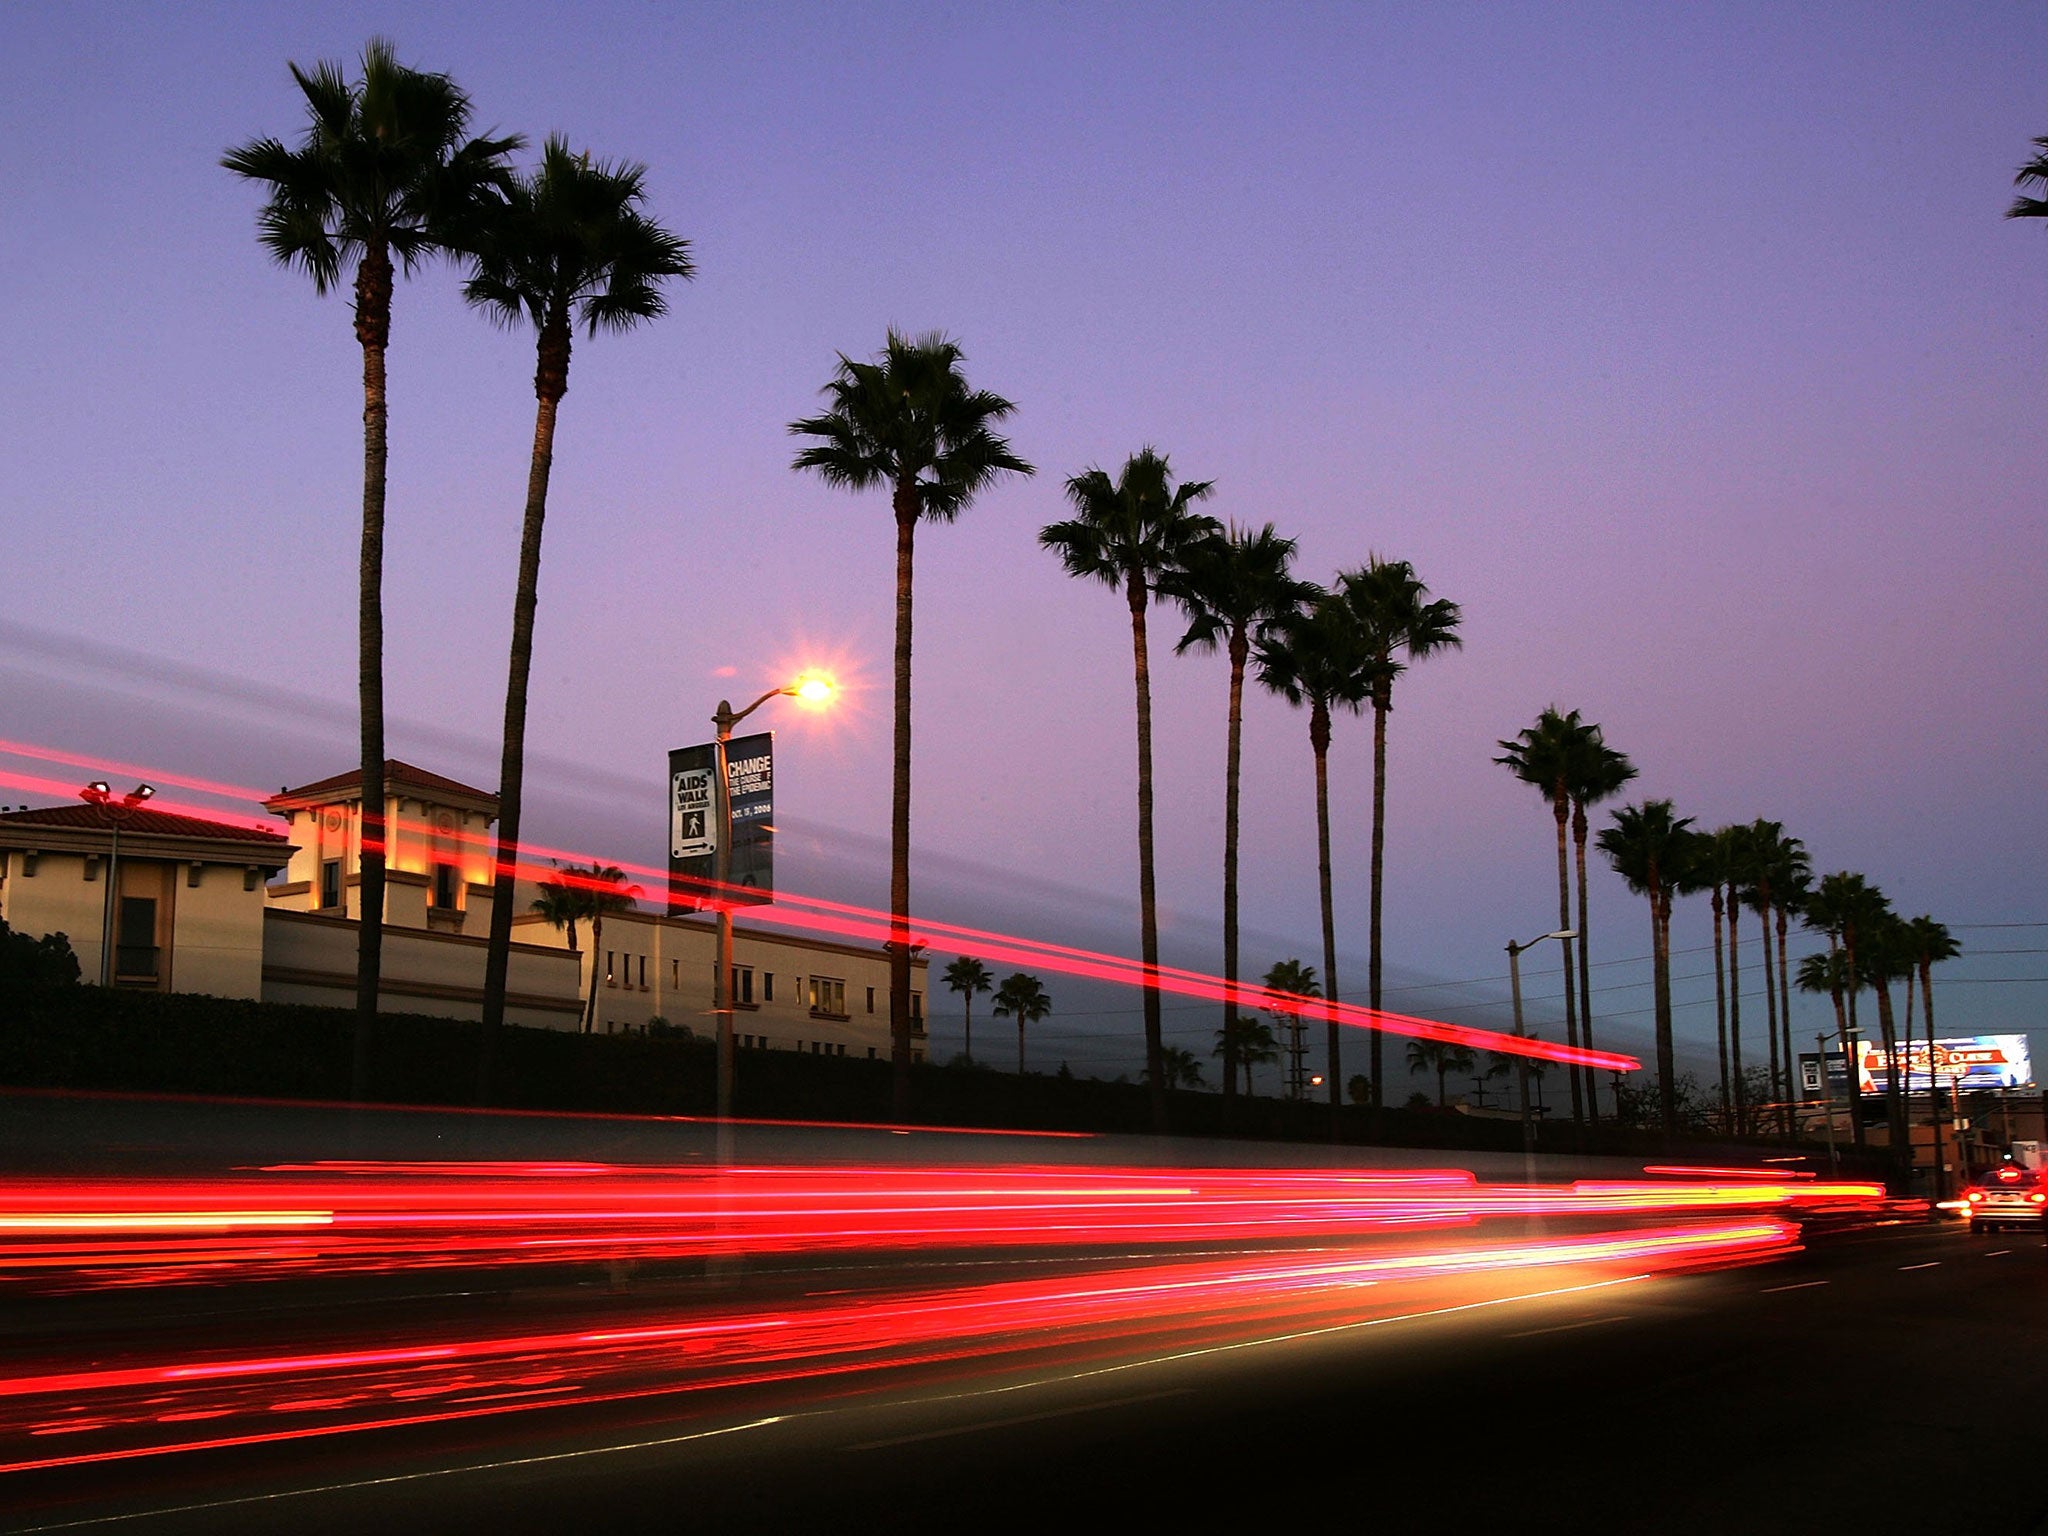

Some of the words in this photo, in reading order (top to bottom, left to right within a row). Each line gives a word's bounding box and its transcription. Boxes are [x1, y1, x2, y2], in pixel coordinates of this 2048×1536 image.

[728, 756, 771, 778] CHANGE
[678, 775, 708, 792] AIDS
[729, 787, 741, 797] THE
[742, 780, 771, 794] EPIDEMIC
[678, 789, 708, 804] WALK
[754, 804, 771, 814] 2006
